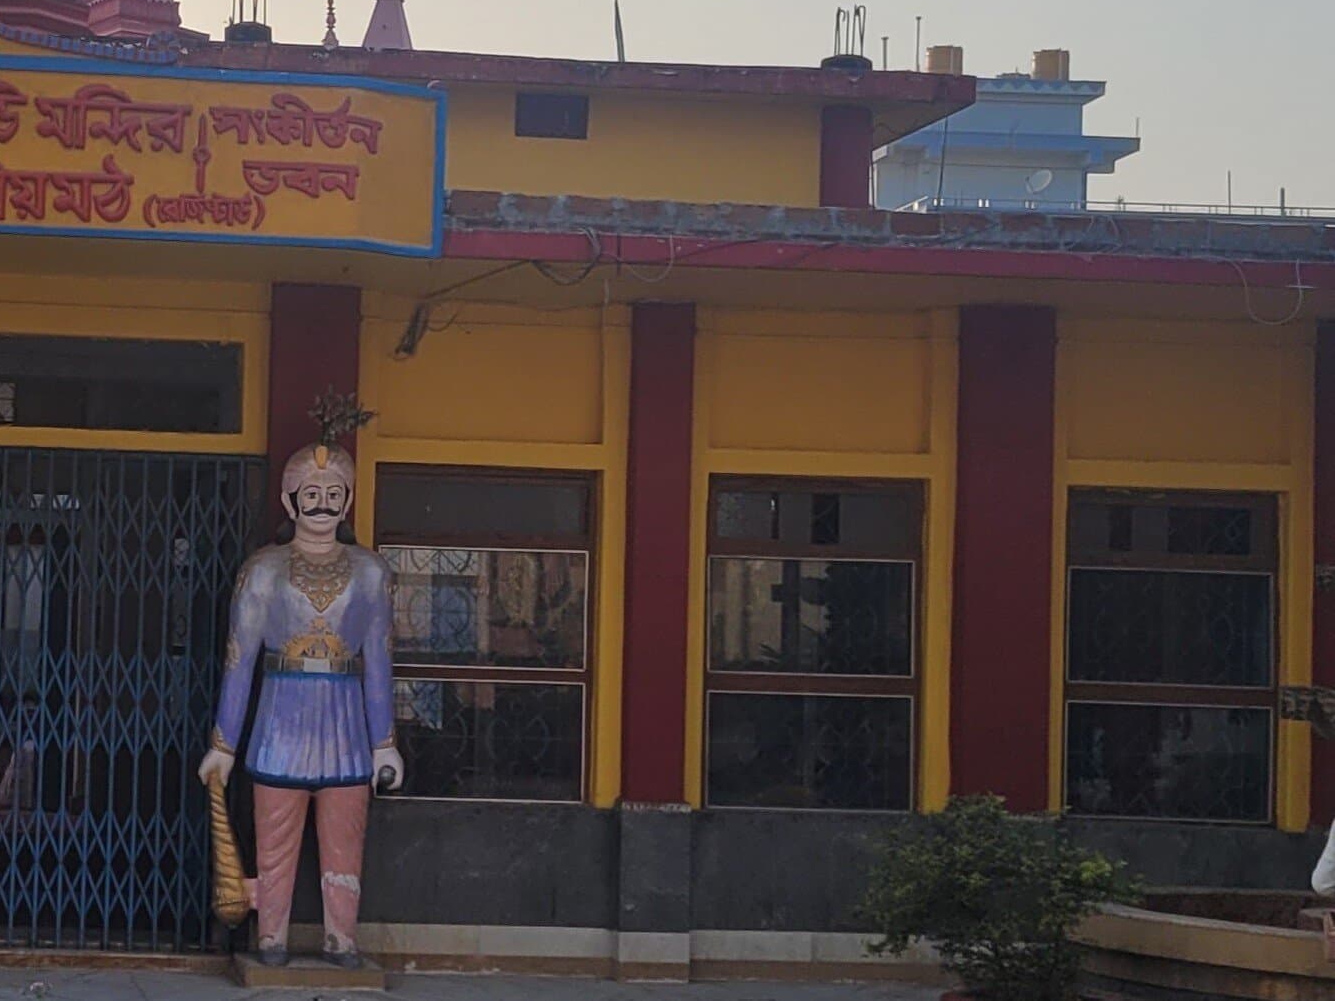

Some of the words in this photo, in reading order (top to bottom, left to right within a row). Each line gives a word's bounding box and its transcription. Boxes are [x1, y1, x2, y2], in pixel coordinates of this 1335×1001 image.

[35, 83, 193, 153] মন্দির
[209, 93, 383, 155] সংকীর্তন
[242, 159, 360, 200] ভবন
